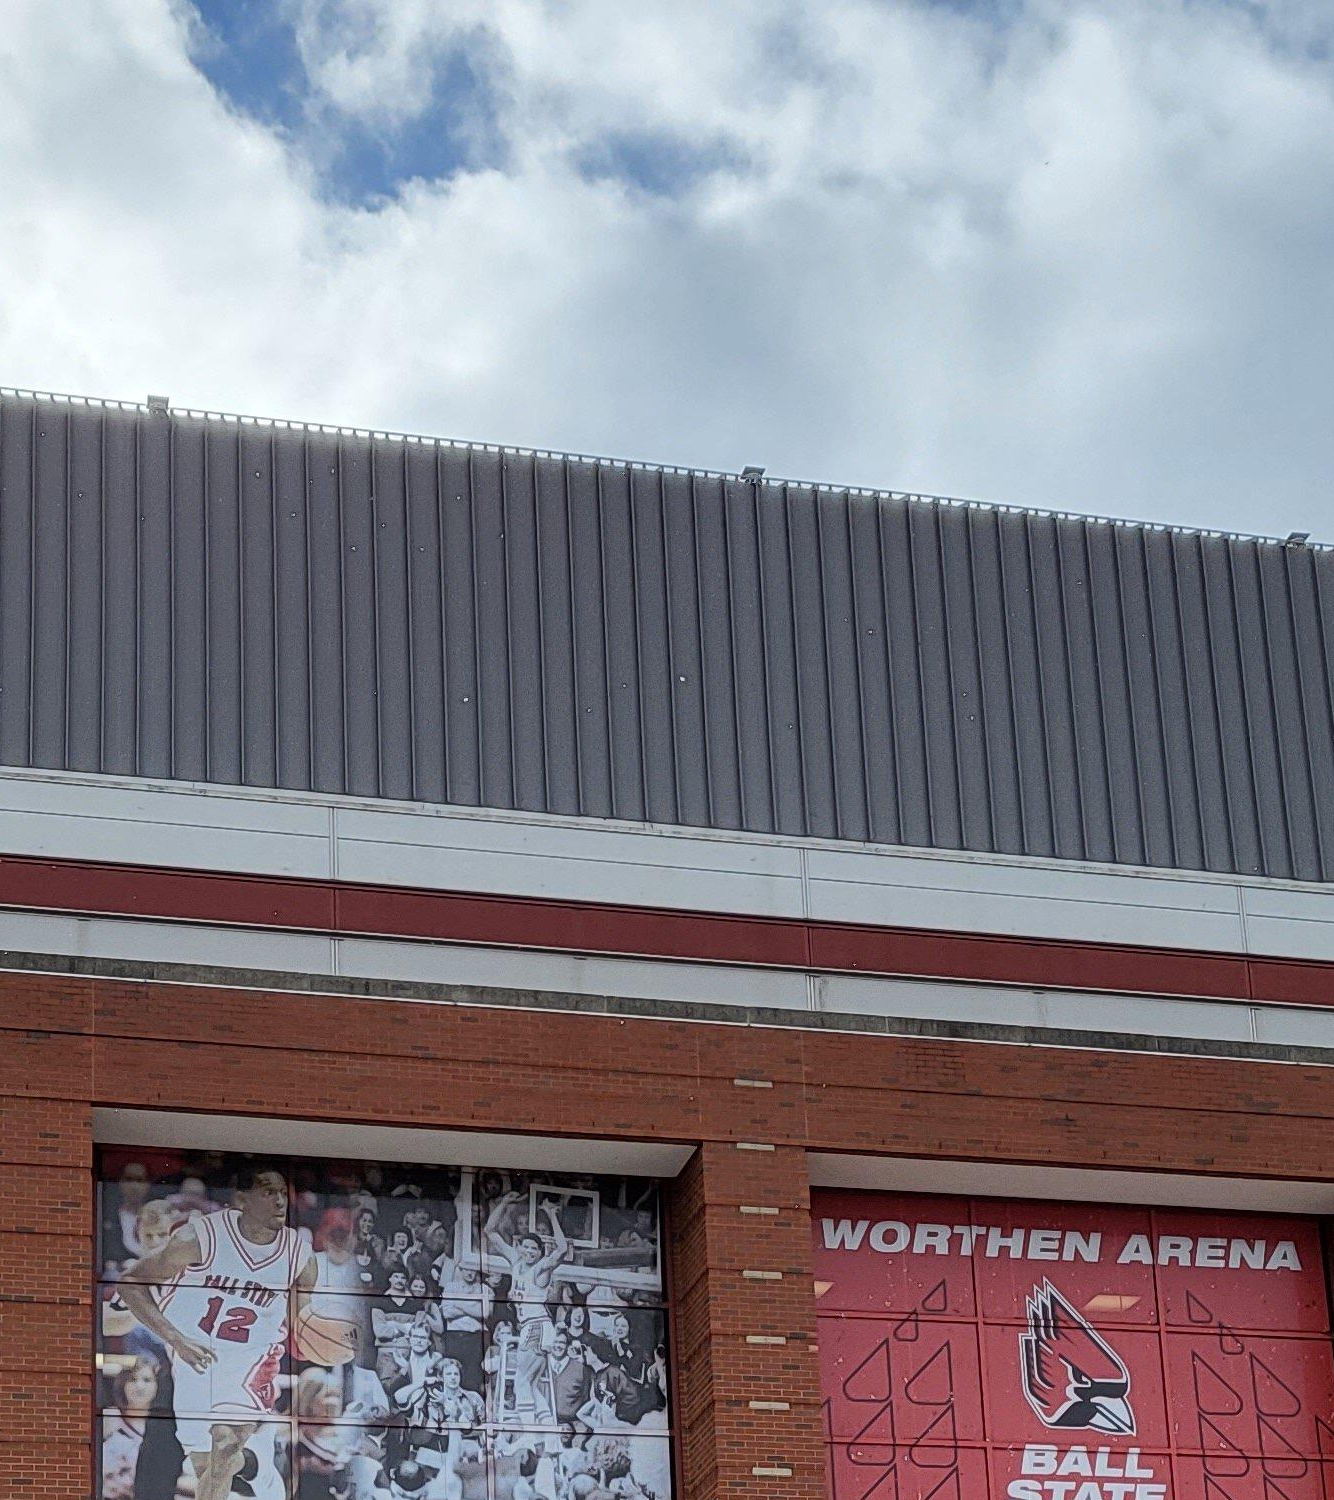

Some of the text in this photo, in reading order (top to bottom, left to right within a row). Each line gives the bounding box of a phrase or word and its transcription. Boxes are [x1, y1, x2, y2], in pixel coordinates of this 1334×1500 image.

[821, 1217, 1304, 1272] WORTHEN ARENA
[198, 1296, 259, 1343] 12
[1020, 1443, 1154, 1479] BALL
